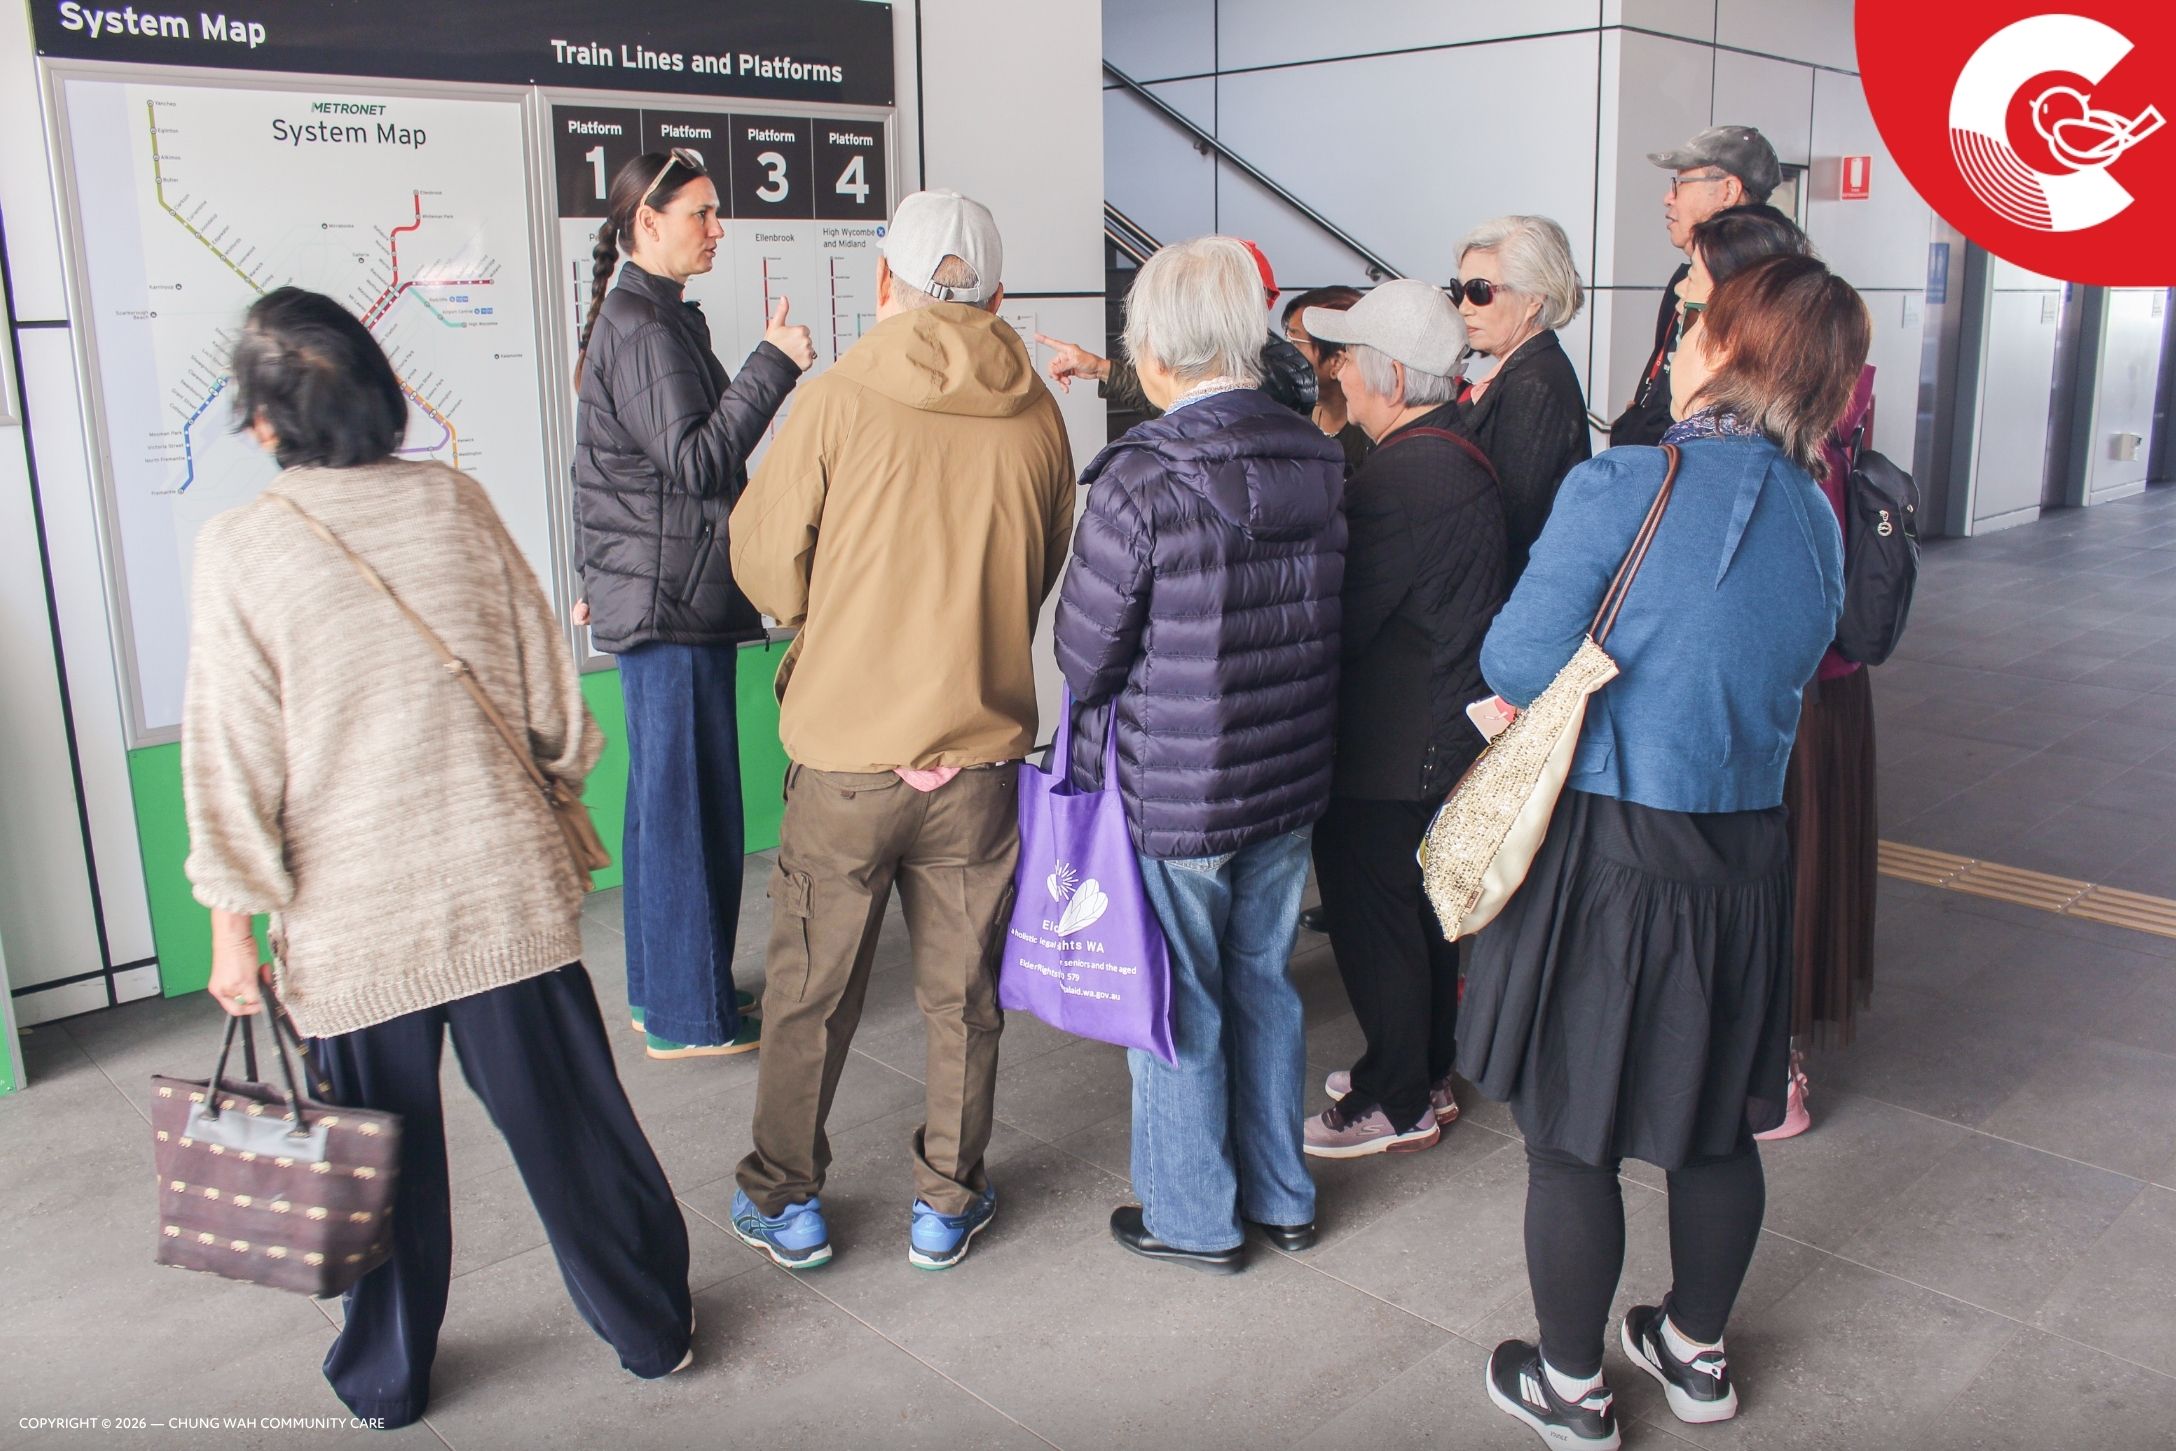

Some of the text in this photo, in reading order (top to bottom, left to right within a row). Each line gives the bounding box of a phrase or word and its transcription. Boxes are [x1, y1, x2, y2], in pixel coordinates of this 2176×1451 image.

[60, 1, 266, 49] System Map
[551, 39, 843, 83] Train Lines and Platforms
[311, 102, 386, 116] METRONET
[272, 119, 427, 149] System Map
[568, 120, 622, 135] Platform
[661, 124, 712, 138] Platform
[747, 128, 796, 142] Platform
[829, 132, 874, 146] Platform
[585, 146, 607, 200] 1
[756, 151, 789, 203] 3
[835, 155, 870, 204] 4
[755, 233, 795, 242] Ellenbrook
[822, 227, 875, 237] High Wycombe
[838, 240, 866, 248] Midland
[1014, 928, 1038, 944] holistic
[1039, 937, 1056, 949] legal
[1086, 940, 1104, 953] WA
[1064, 960, 1137, 976] seniors and the aged
[1067, 973, 1080, 982] 579
